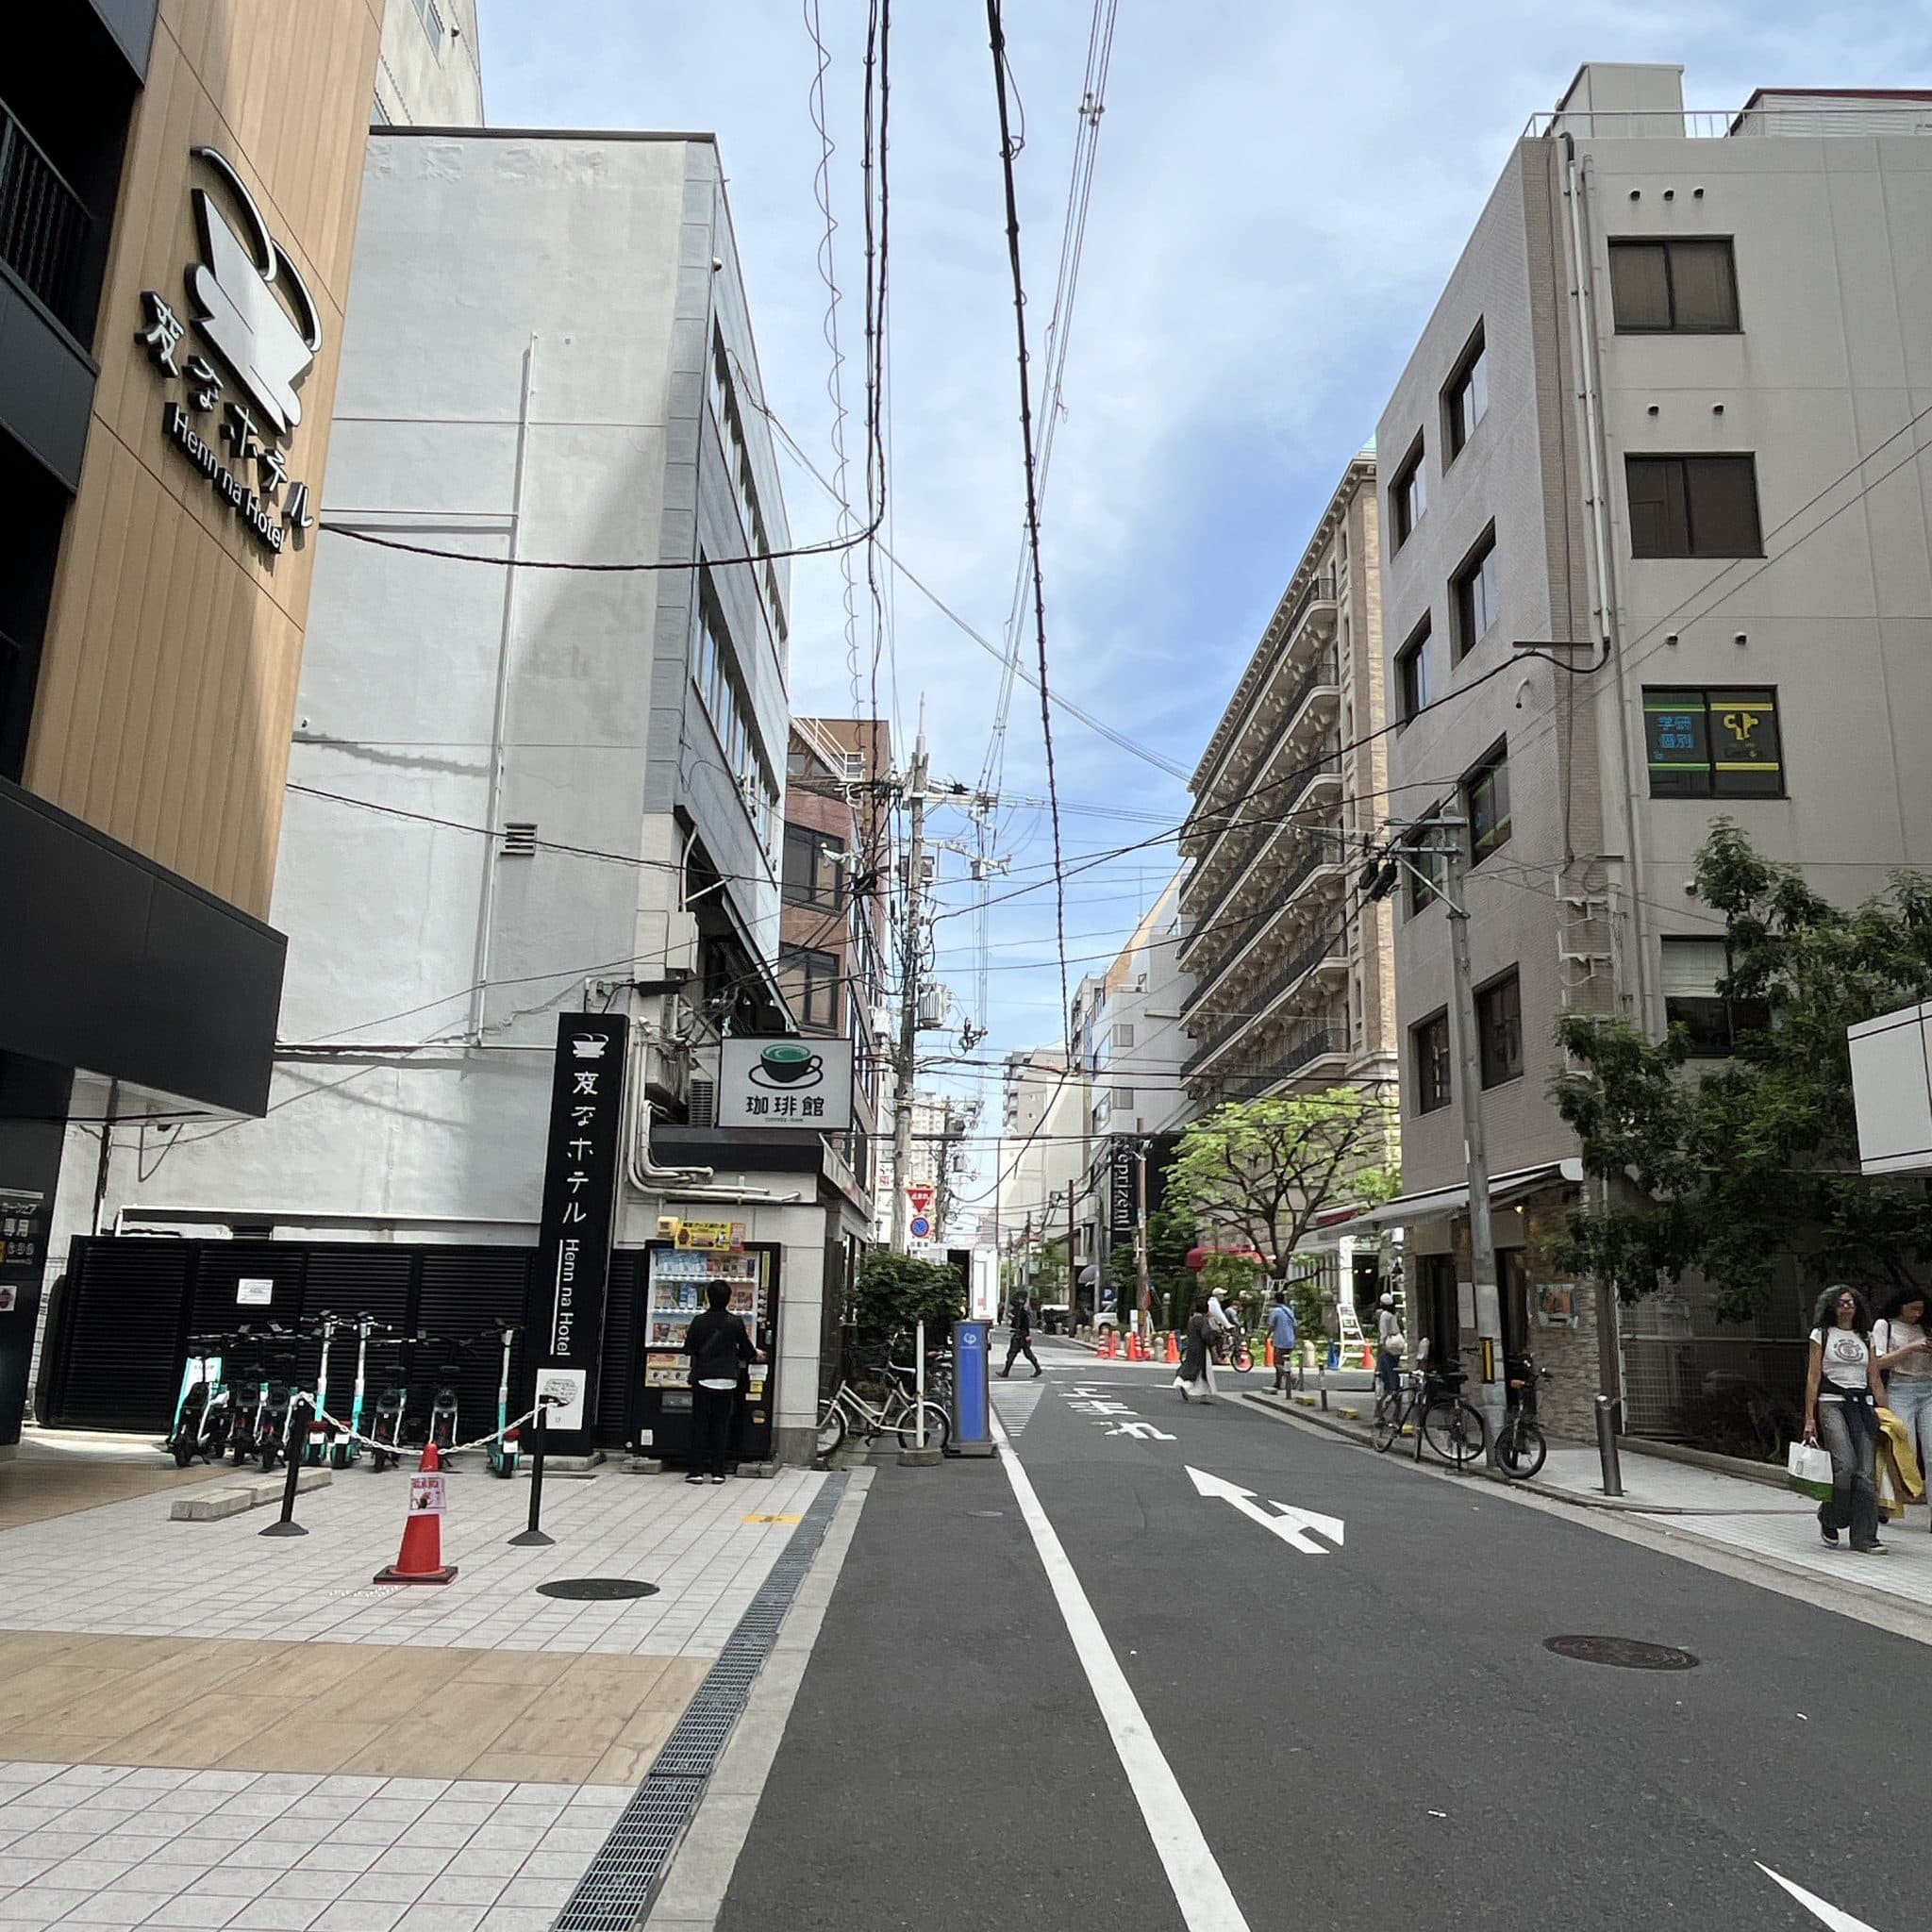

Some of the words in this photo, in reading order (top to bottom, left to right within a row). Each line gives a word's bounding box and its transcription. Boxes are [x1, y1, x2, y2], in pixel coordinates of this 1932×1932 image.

[144, 291, 313, 528] 変なホテル
[172, 404, 219, 478] Henn
[222, 471, 243, 506] na
[245, 495, 286, 554] Hotel
[745, 1095, 824, 1117] 珈琲館
[562, 1071, 600, 1224] 変なホテル
[563, 1239, 580, 1282] Henn
[560, 1287, 573, 1307] na
[557, 1312, 575, 1356] Hotel
